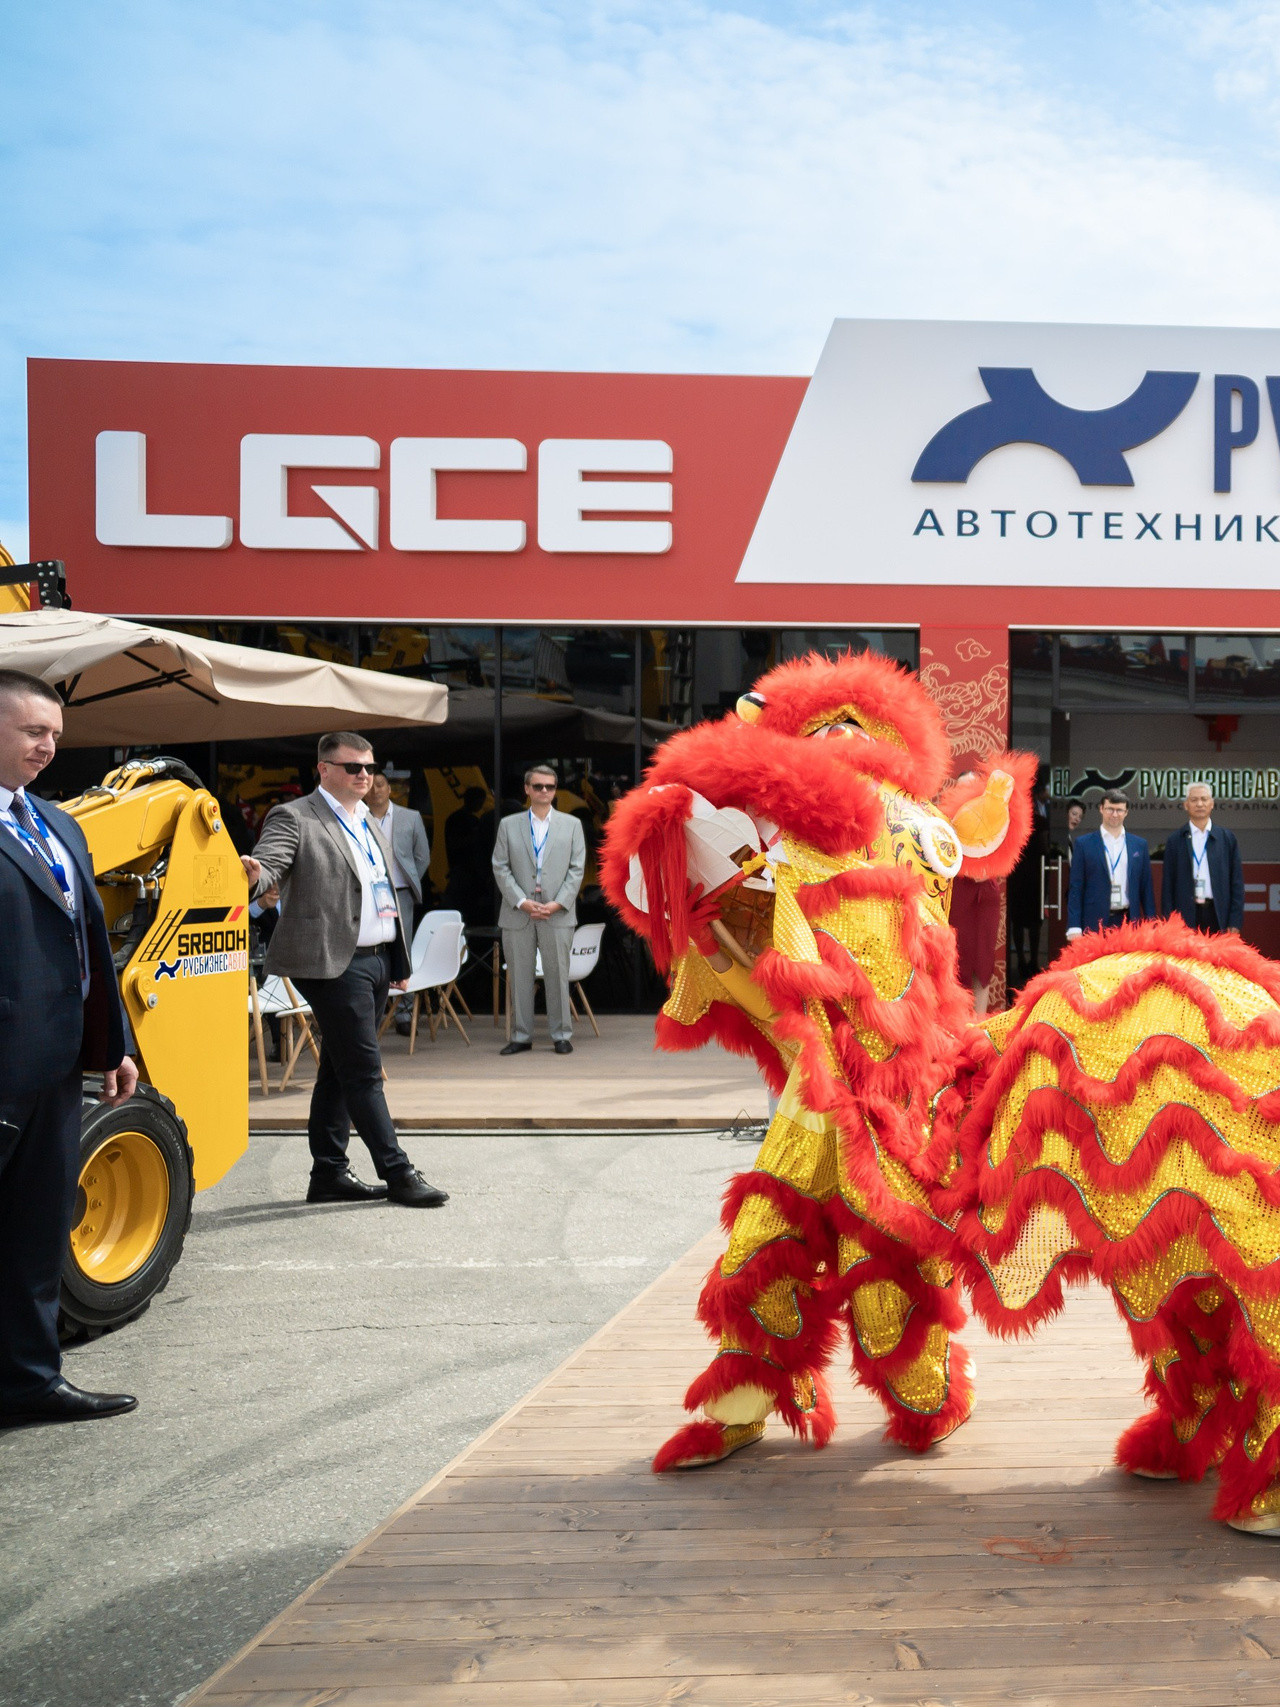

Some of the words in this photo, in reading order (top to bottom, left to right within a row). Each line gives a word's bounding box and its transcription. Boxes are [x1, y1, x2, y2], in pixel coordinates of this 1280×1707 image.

[95, 430, 673, 553] LGCE
[178, 929, 246, 956] SR800H
[183, 951, 247, 976] РУСБИЗНЕСАВТО
